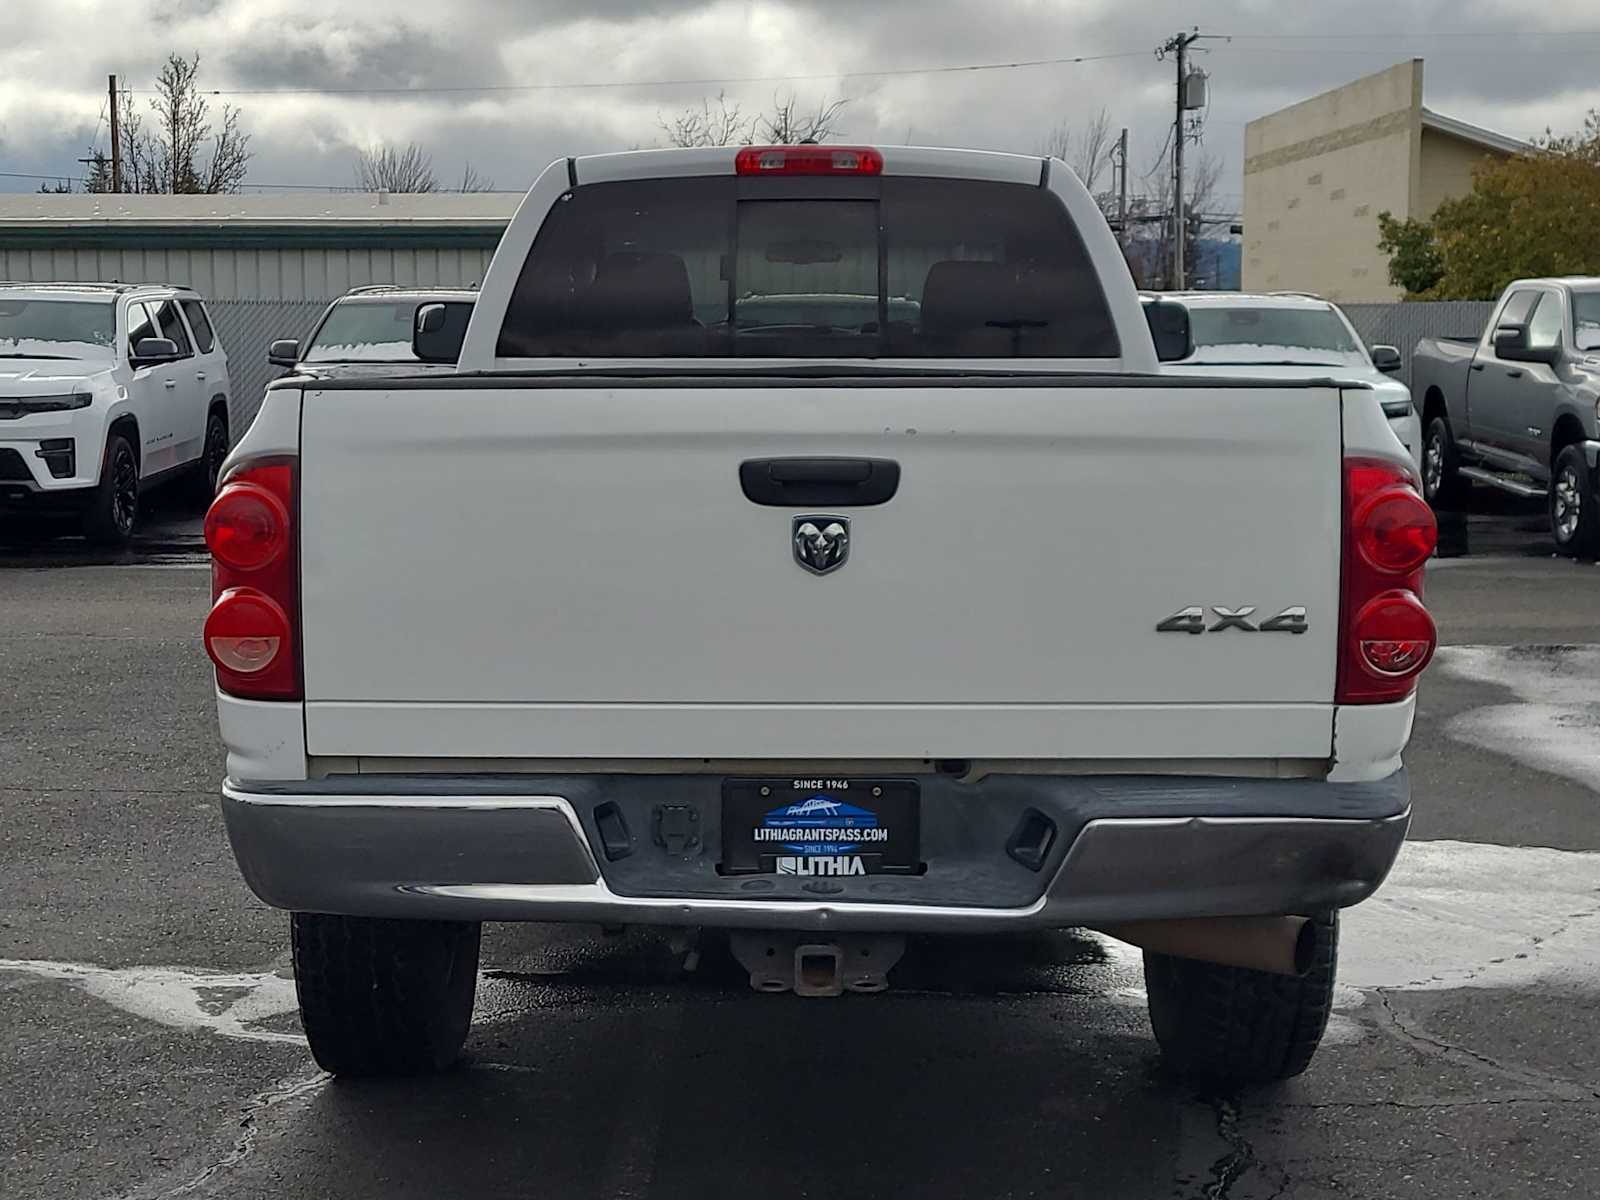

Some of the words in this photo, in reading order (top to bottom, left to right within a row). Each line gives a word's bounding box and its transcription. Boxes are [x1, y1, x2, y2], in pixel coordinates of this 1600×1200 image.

[793, 780, 824, 789] SINCE
[826, 780, 849, 789] 1946
[754, 828, 888, 842] LITHIAGRANTSPASS.COM
[796, 856, 866, 875] LITHIA
